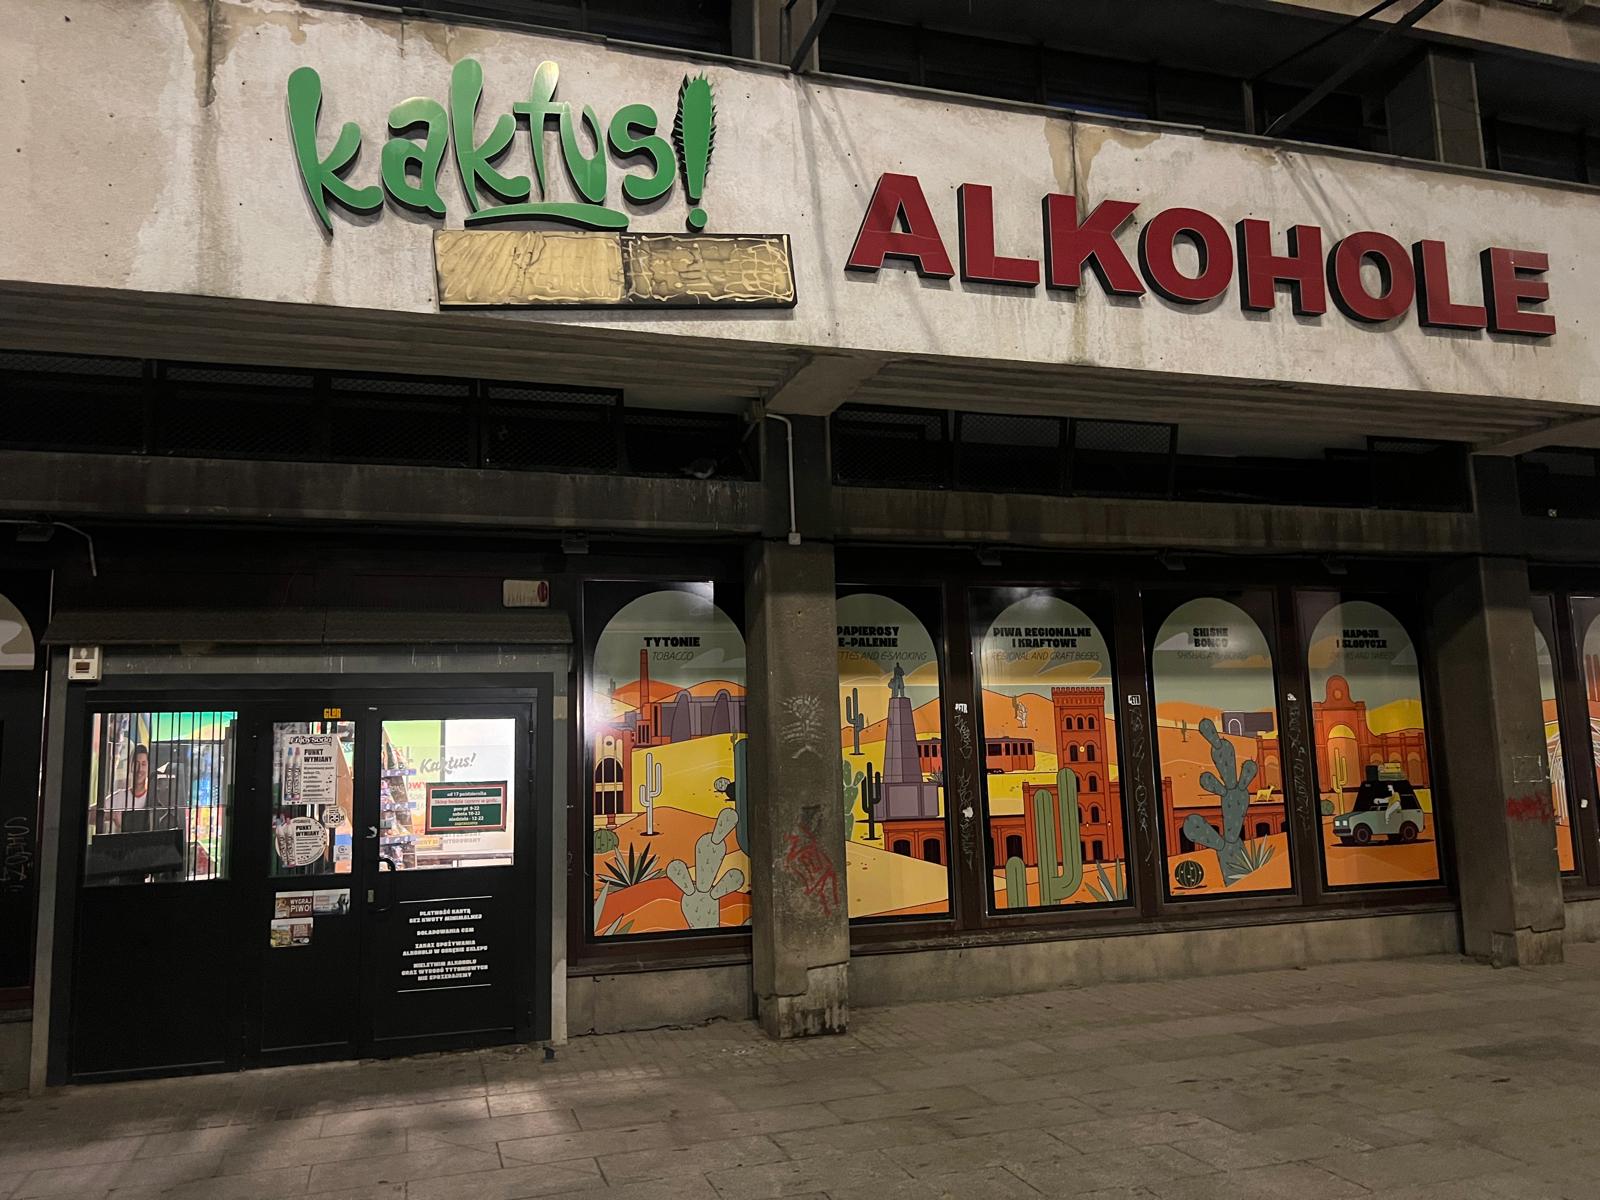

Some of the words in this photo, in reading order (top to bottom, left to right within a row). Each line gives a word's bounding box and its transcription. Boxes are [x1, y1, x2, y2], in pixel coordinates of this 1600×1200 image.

[287, 58, 717, 236] kaktus!
[844, 172, 1557, 337] ALKOHOLE
[837, 626, 899, 636] PAPIEROSY
[993, 627, 1022, 637] PIWA
[1025, 627, 1091, 637] REGIONALNE
[1342, 629, 1379, 638] NAPOJE
[644, 637, 700, 647] TYTONIE
[838, 637, 898, 647] E-PALENIE
[1018, 638, 1077, 648] KRAFTOWE
[652, 651, 694, 661] TOBACCO
[290, 904, 312, 912] PIWO!
